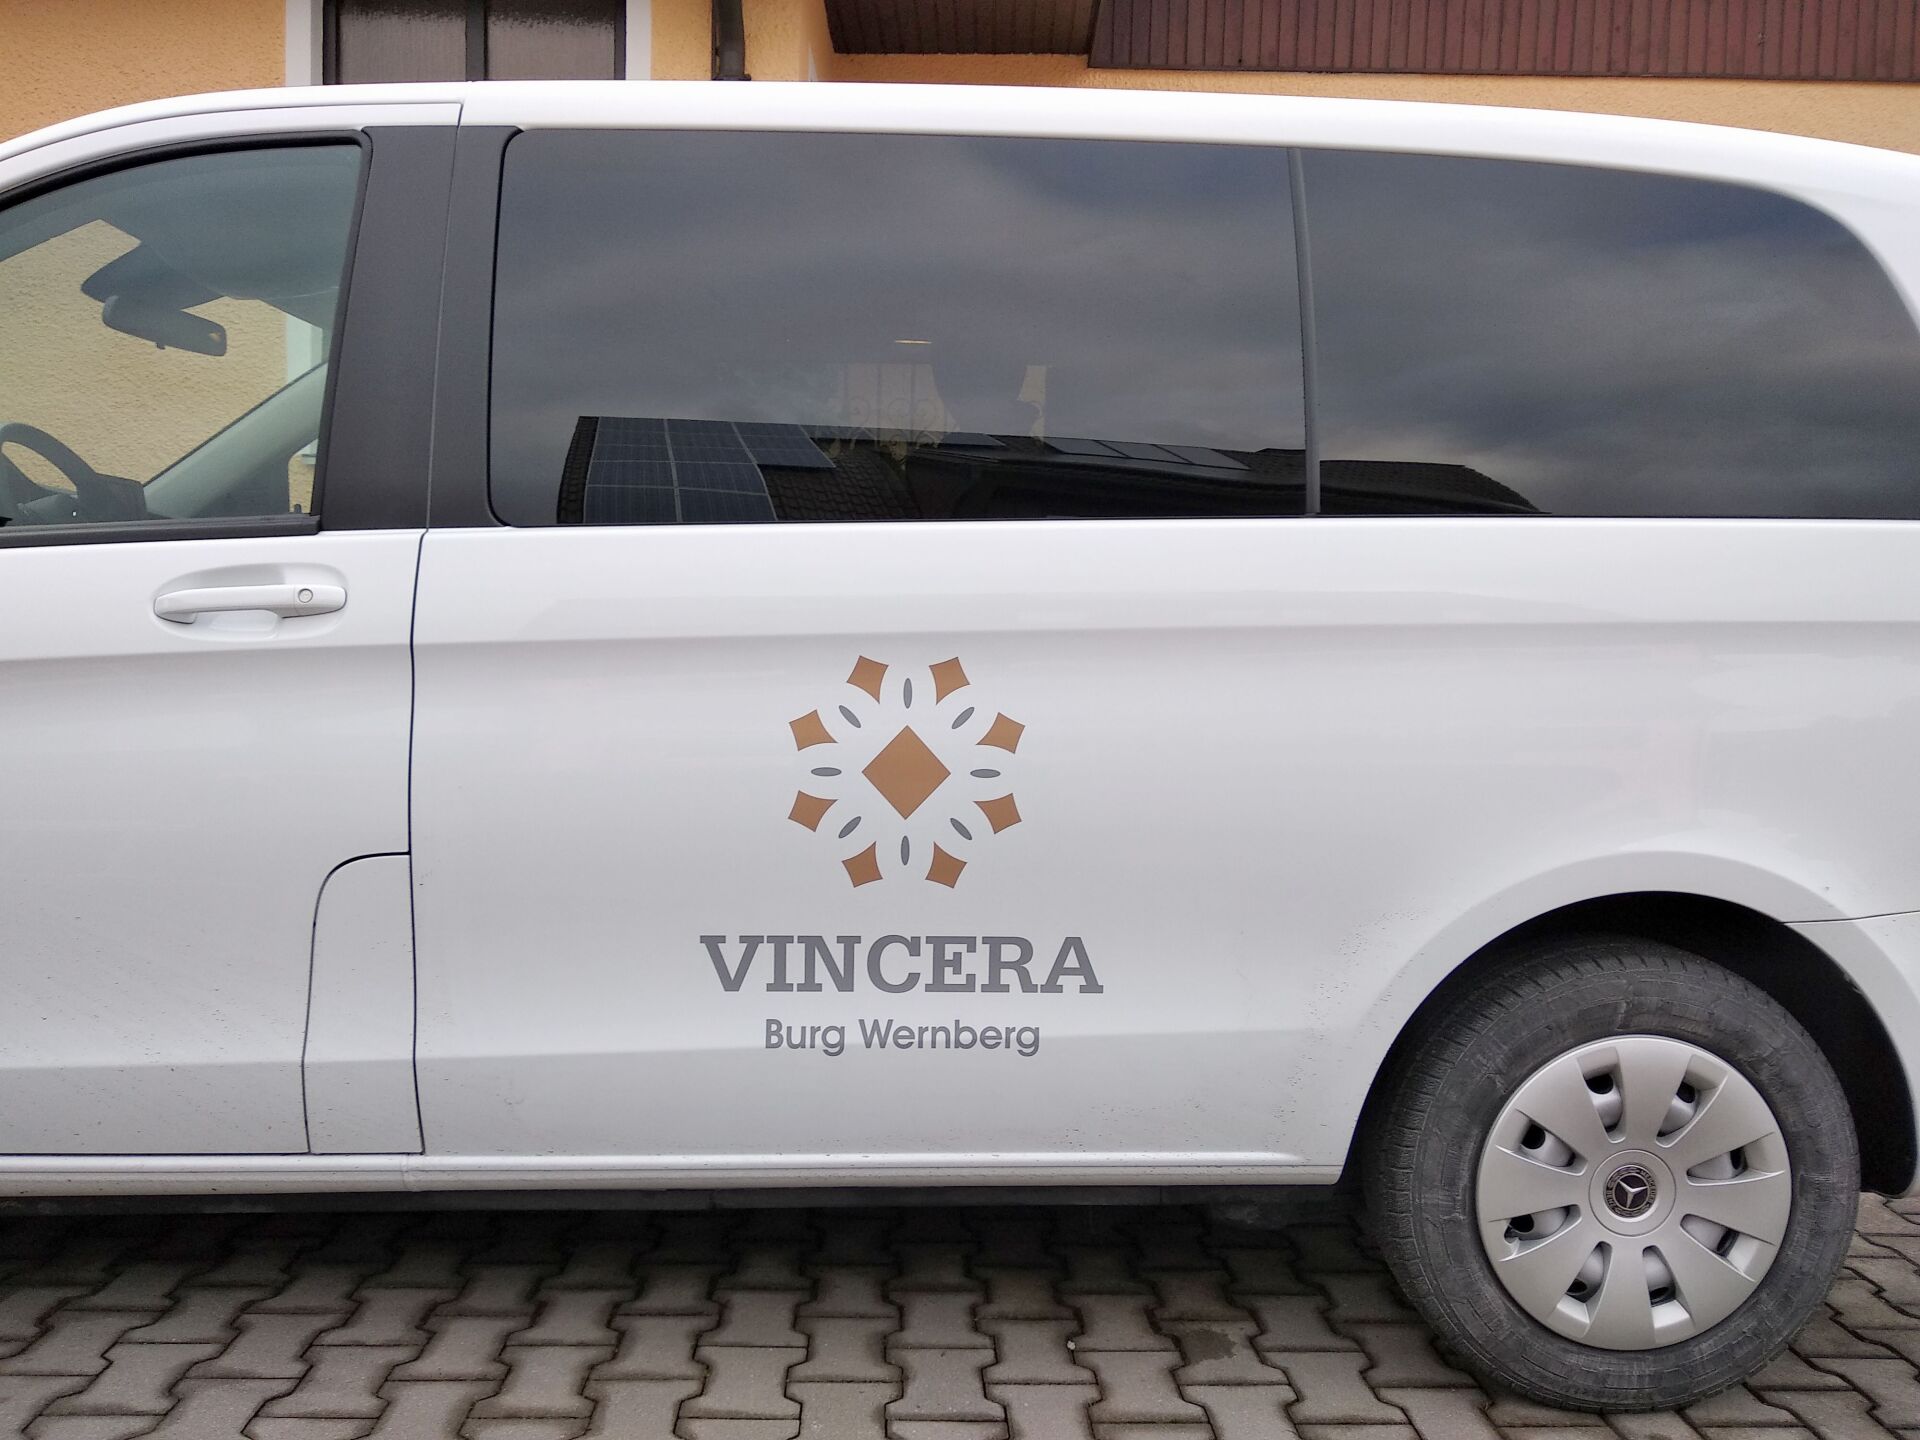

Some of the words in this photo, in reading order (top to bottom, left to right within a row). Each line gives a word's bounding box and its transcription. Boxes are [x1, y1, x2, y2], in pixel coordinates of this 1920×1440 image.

[700, 935, 1104, 993] VINCERA
[765, 1019, 845, 1057] Burg
[858, 1019, 1040, 1057] Wernberg
